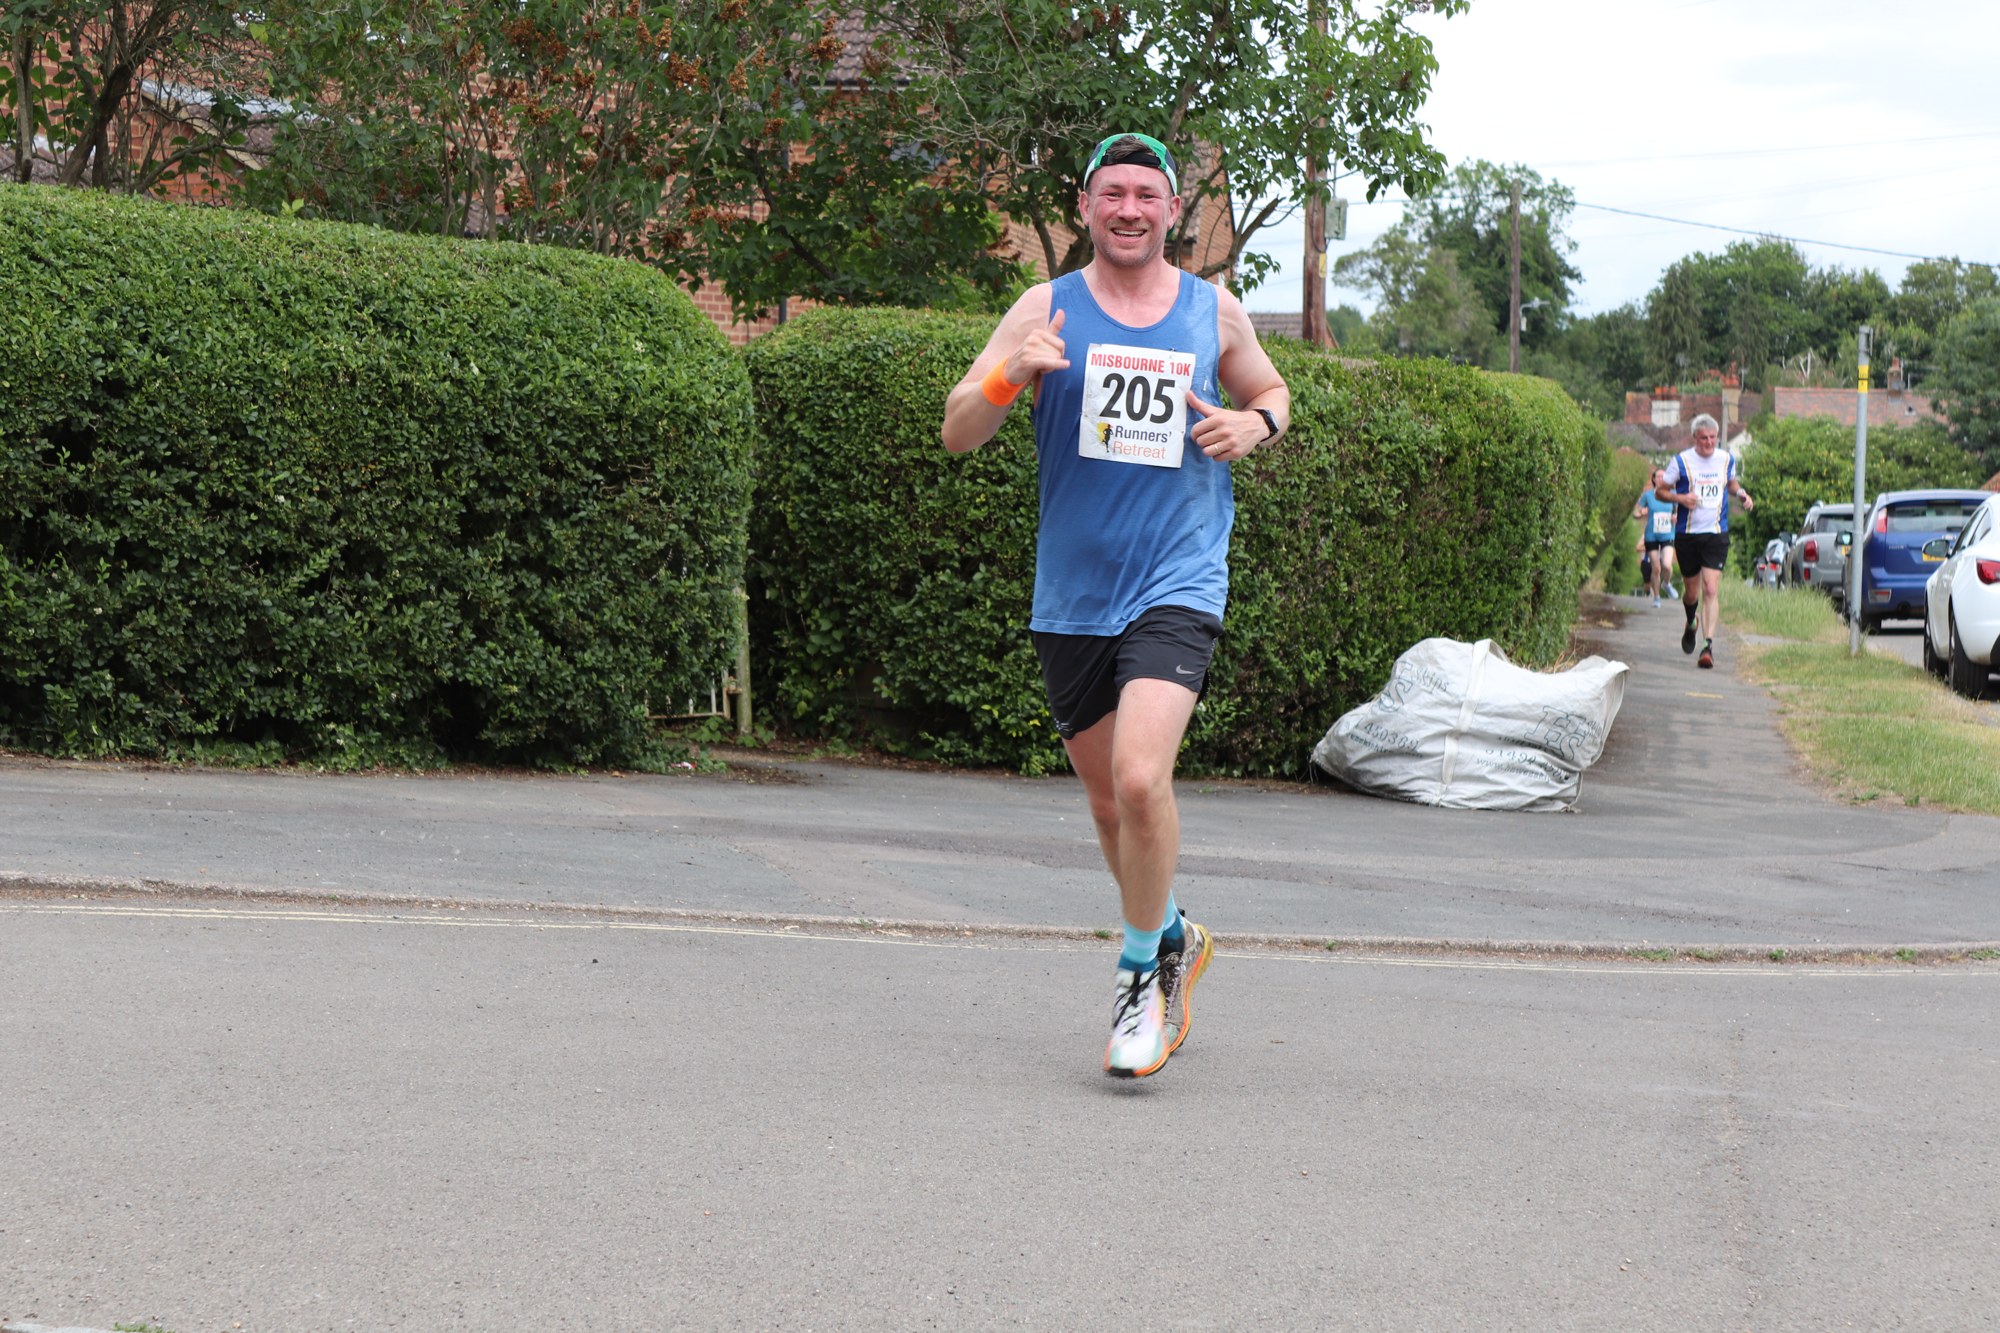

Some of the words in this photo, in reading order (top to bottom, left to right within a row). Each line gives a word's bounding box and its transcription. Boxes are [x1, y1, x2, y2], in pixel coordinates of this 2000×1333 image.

[1090, 353, 1165, 373] MISBOURNE
[1170, 362, 1191, 376] 10K
[1099, 372, 1176, 424] 205
[1114, 425, 1172, 443] Runners'
[1113, 441, 1166, 459] Retreat
[1701, 485, 1718, 497] 120
